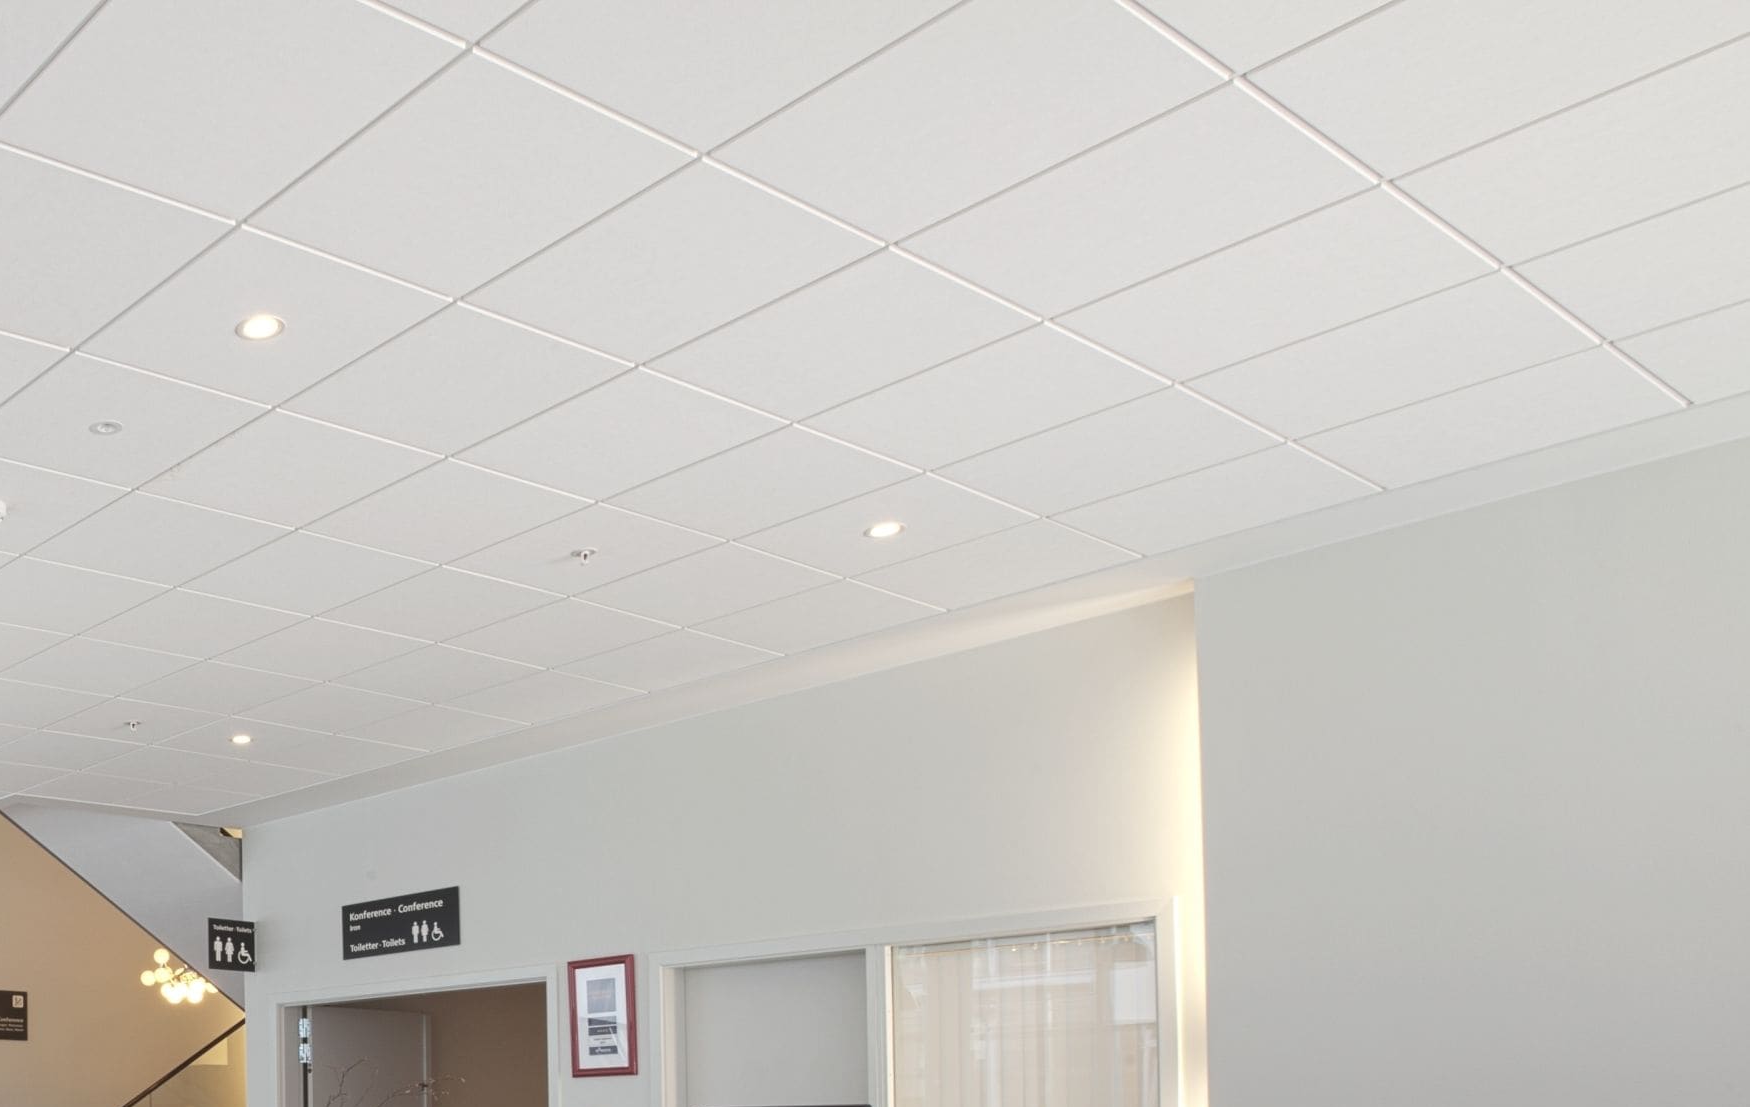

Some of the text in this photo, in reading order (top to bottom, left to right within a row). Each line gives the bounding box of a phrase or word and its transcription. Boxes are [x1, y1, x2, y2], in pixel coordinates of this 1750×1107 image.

[349, 900, 443, 921] Konference Conference
[350, 938, 406, 952] Toiletter Toilets
